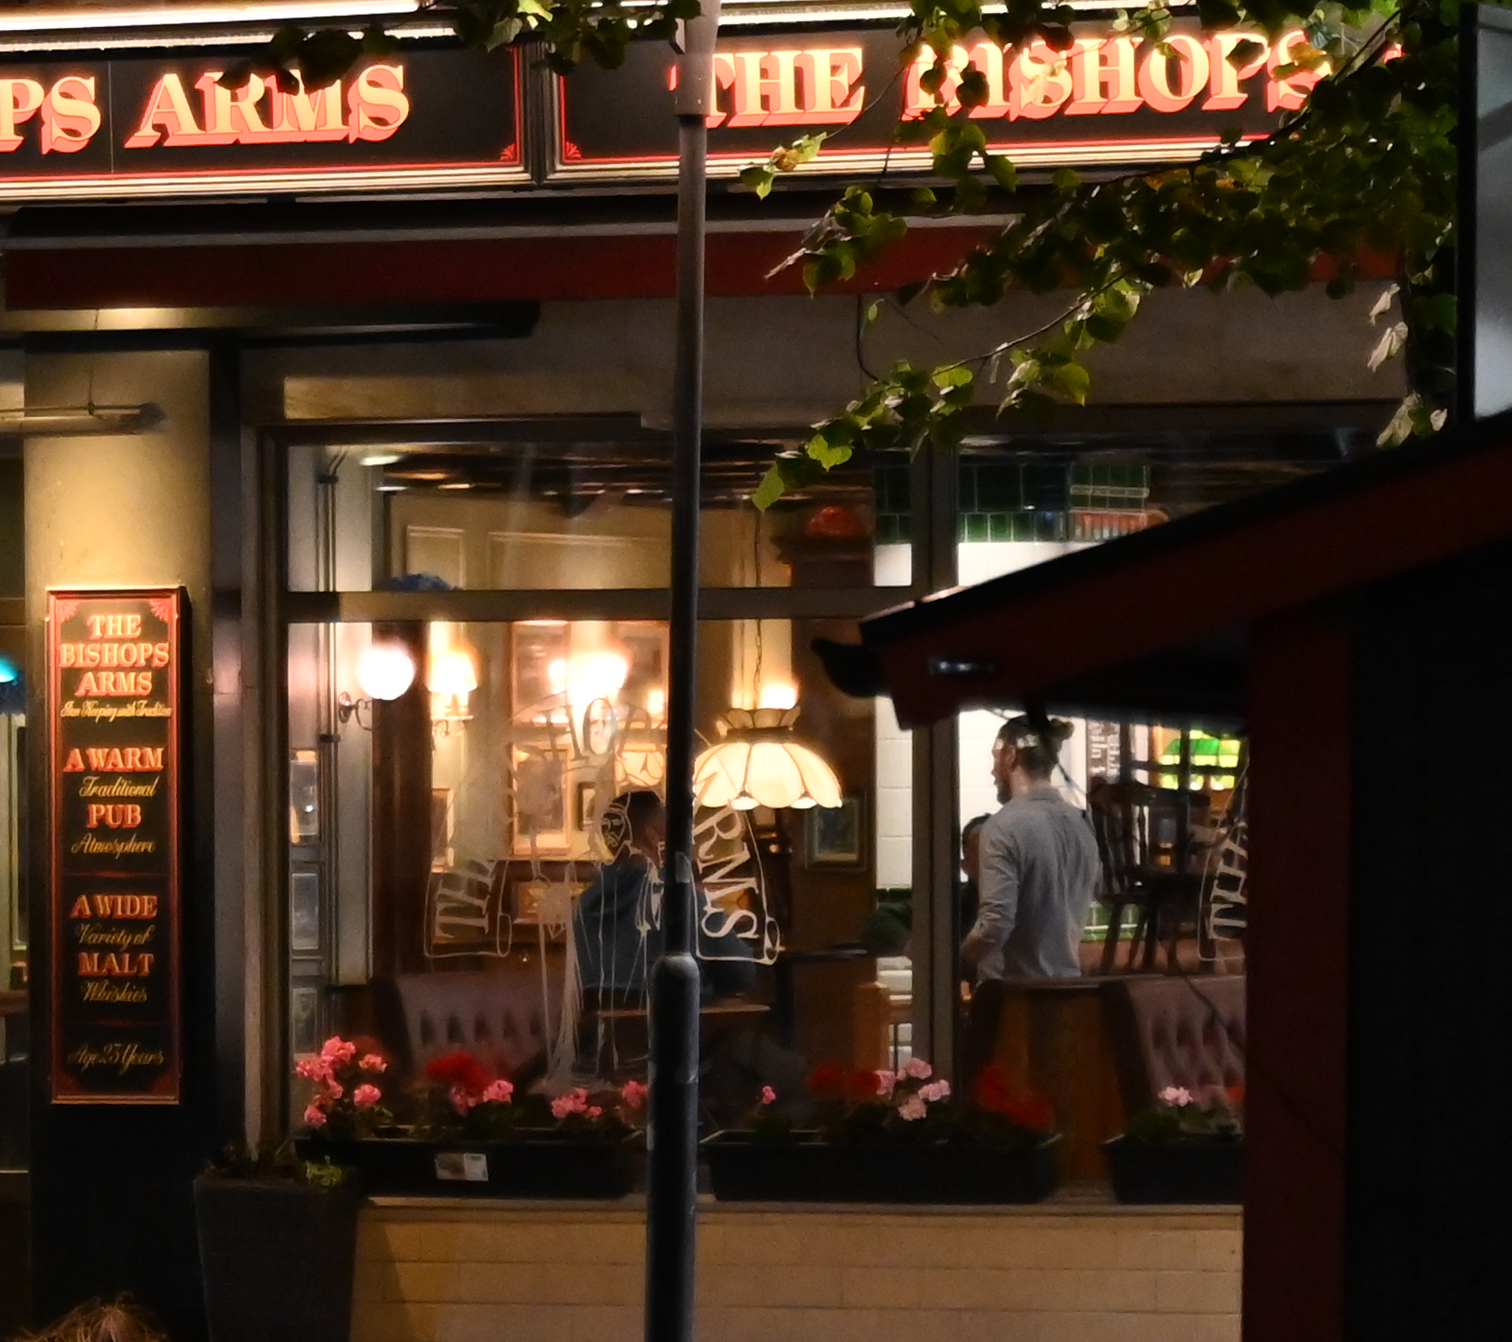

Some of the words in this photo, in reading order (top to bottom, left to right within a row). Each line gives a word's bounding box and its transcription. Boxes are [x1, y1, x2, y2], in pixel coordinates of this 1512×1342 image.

[124, 64, 410, 148] ARMS
[86, 613, 142, 640] THE
[59, 642, 170, 668] BISHOPS
[75, 671, 153, 697] ARMS
[63, 748, 87, 773] A
[86, 747, 165, 773] WARM
[78, 775, 160, 798] Traditional
[87, 803, 143, 829] PUB
[71, 832, 157, 860] Atmosphere
[70, 894, 93, 919] A
[93, 894, 159, 919] WIDE
[75, 923, 133, 952] Variety
[133, 924, 156, 946] of
[78, 952, 155, 977] MALT
[80, 979, 149, 1003] Whiskies
[120, 1043, 165, 1077] Years
